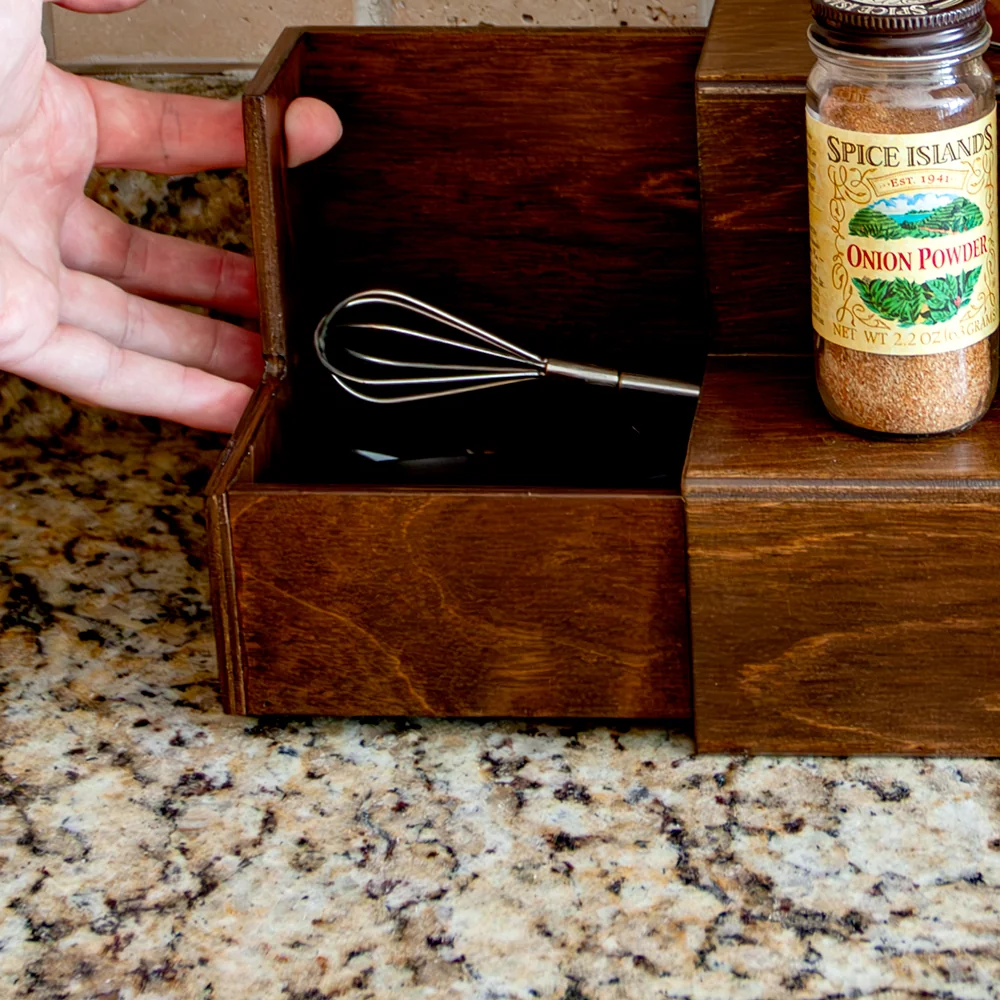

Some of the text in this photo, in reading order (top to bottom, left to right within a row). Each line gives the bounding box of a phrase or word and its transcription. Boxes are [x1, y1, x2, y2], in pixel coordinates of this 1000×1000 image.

[827, 123, 993, 167] SPICE ISLANDS
[891, 174, 950, 187] EST. 1941
[847, 235, 988, 271] ONION POWDER
[833, 323, 856, 341] NET
[864, 330, 888, 346] WT
[894, 332, 916, 346] 2.2
[921, 331, 941, 346] OZ
